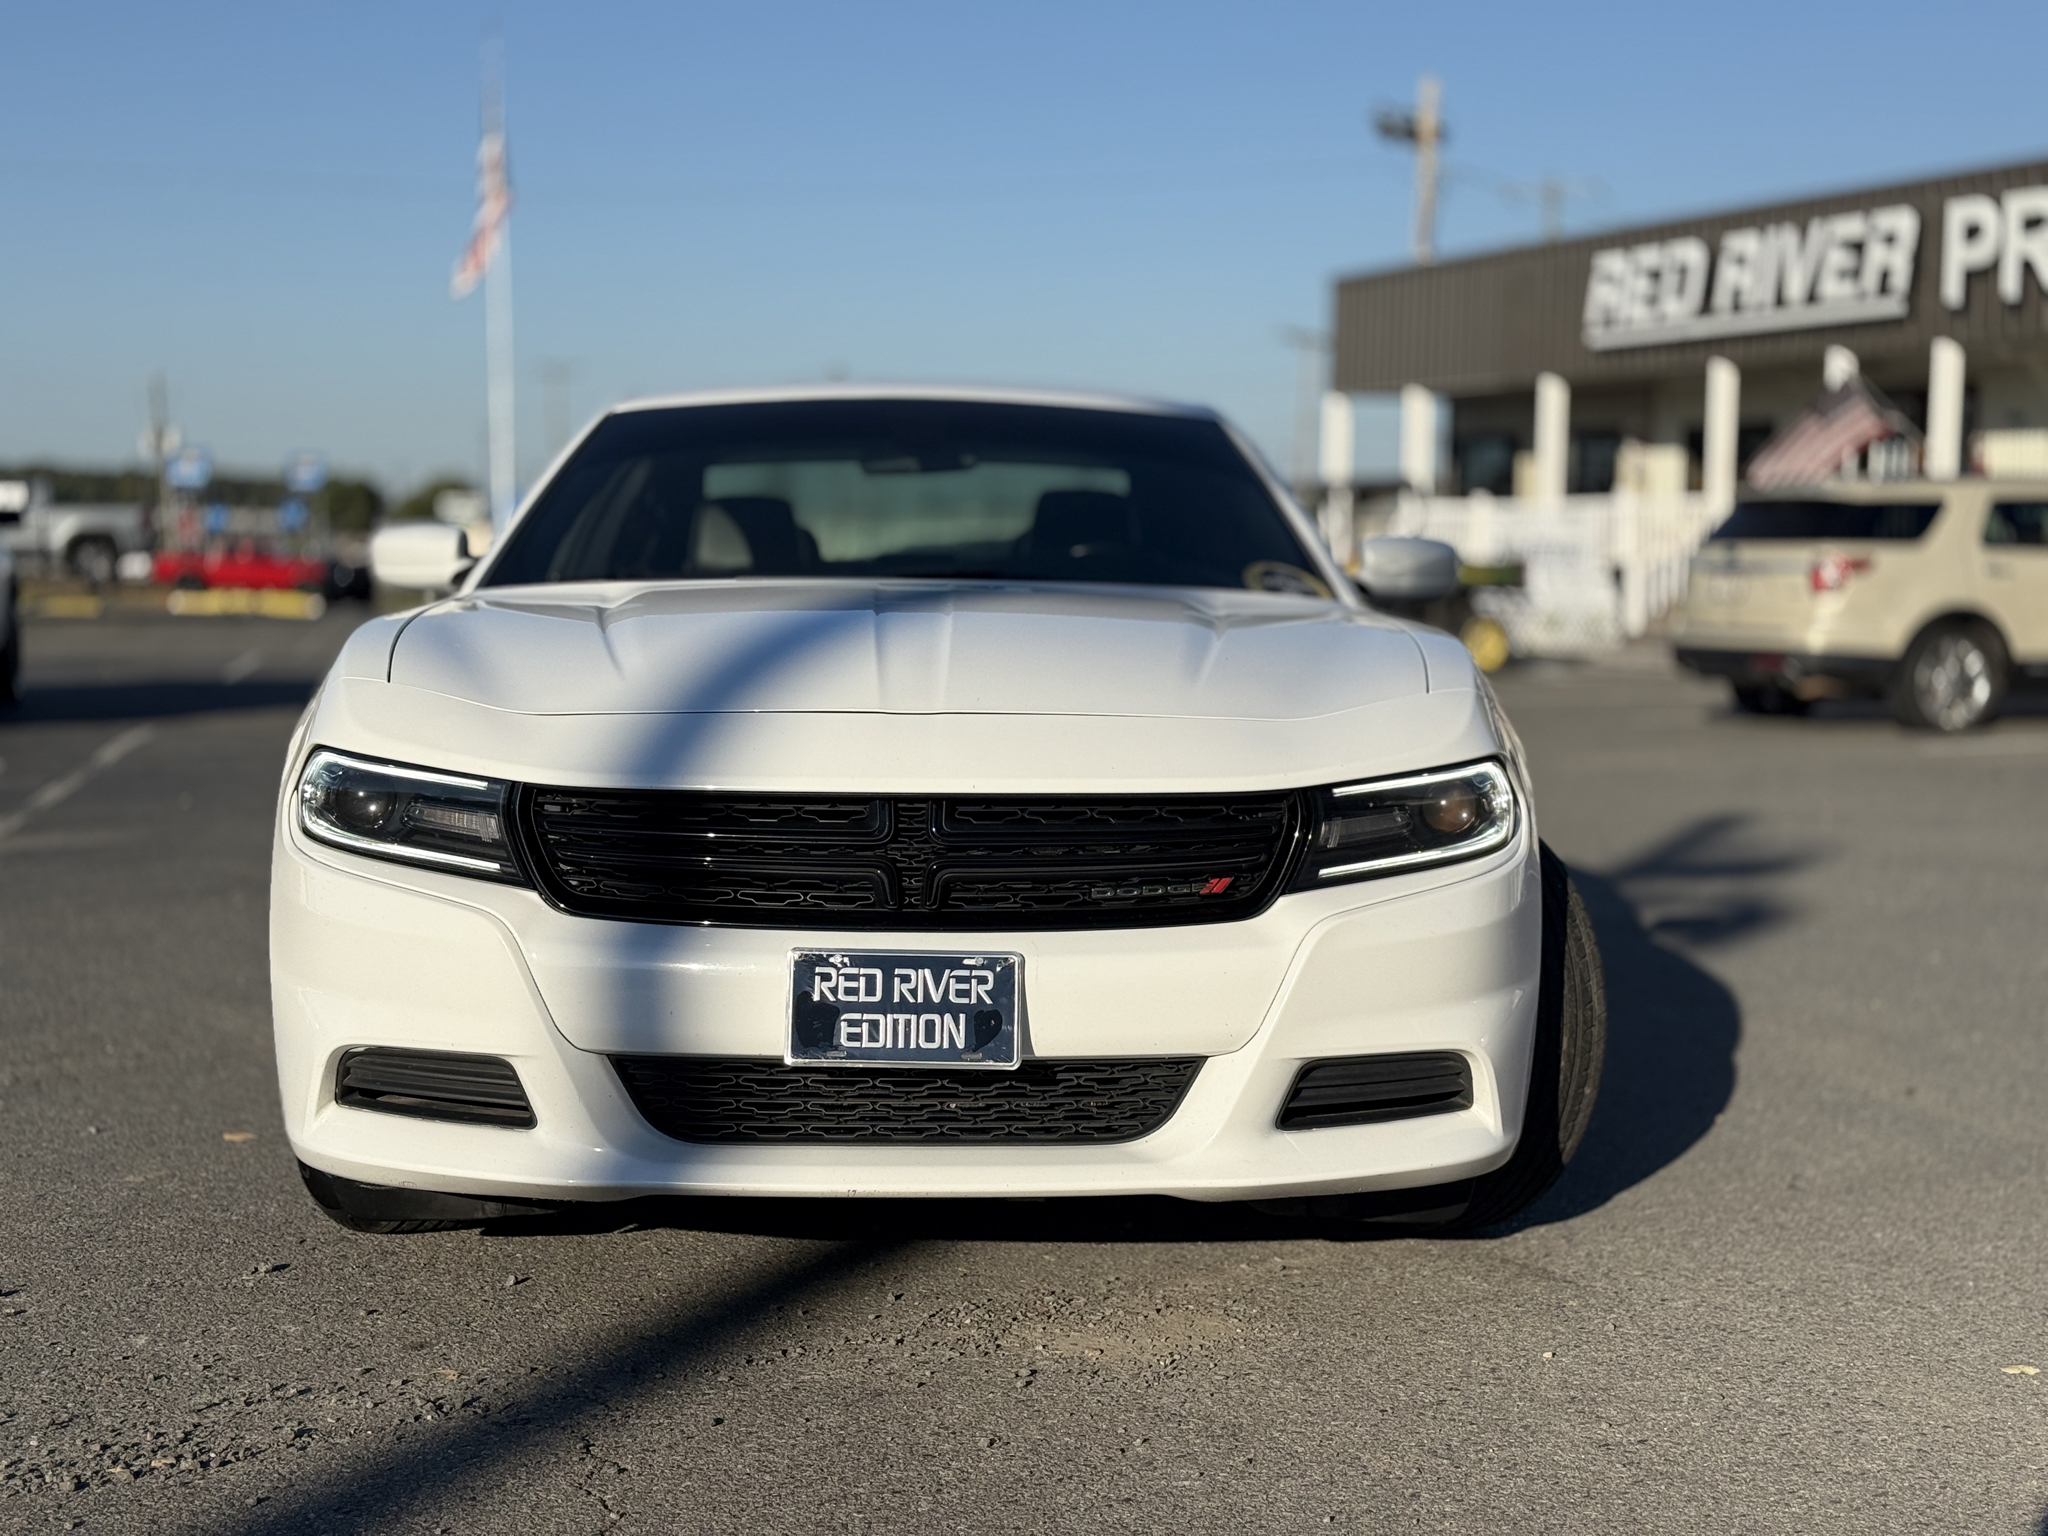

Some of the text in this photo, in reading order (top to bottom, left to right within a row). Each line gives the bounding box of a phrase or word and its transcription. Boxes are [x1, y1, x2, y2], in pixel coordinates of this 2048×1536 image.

[1583, 184, 2048, 332] RED RIVER PR
[814, 967, 994, 1004] RED RIVER
[840, 1013, 966, 1049] EDITION
